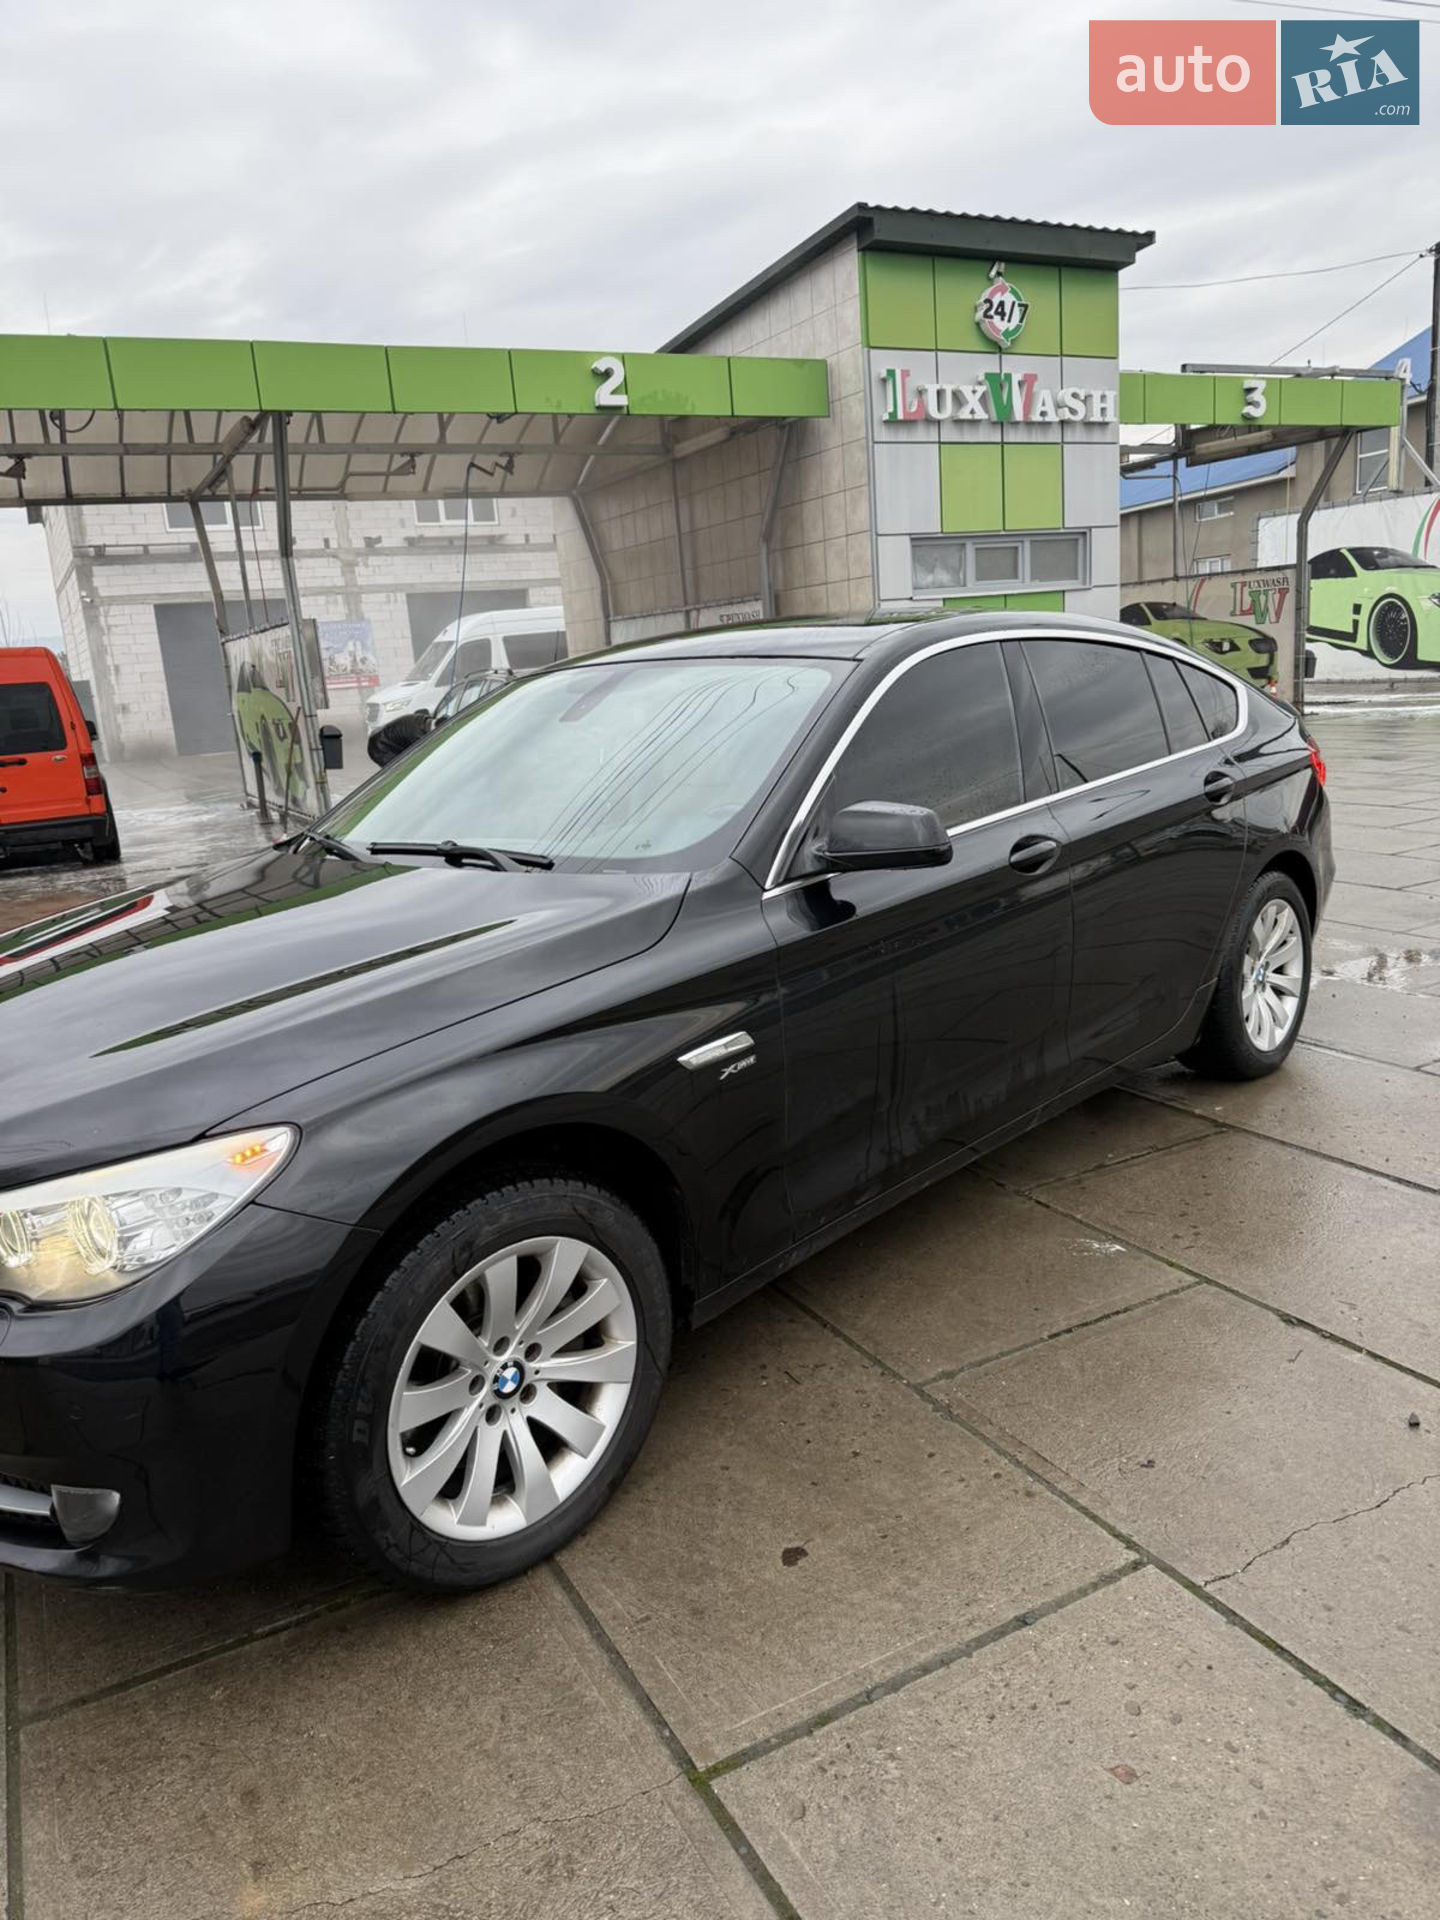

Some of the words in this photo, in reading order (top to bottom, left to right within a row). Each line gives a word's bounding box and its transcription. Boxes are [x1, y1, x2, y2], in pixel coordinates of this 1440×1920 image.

[982, 297, 1029, 324] 24/7
[591, 355, 629, 408] 2
[1394, 357, 1413, 385] 4
[1241, 379, 1268, 419] 3
